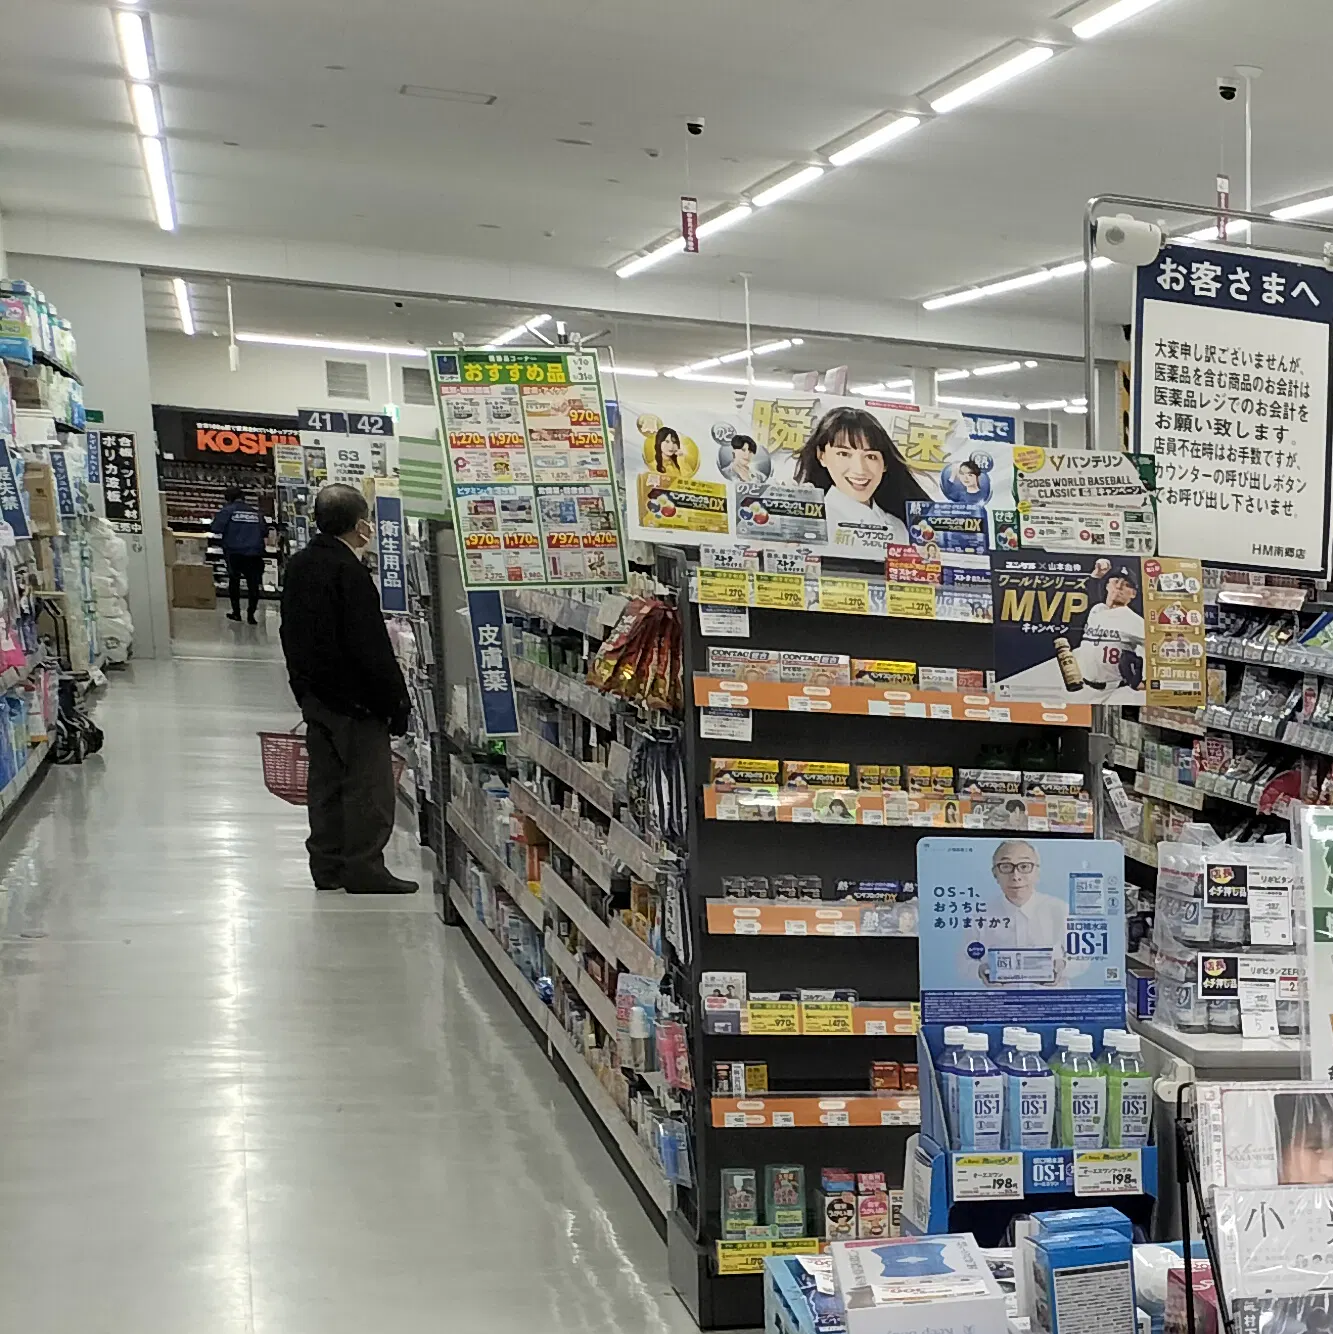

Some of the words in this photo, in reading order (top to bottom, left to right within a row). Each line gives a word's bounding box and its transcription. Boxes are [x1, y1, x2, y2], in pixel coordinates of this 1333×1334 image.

[1156, 257, 1320, 307] お客さまへ
[1154, 339, 1304, 376] 大変申し訳ございませんが、
[463, 362, 567, 383] おすすめ品
[1154, 362, 1311, 399] 医薬品を含む商品のお会計は
[1153, 386, 1309, 423] 医薬品レジでのお会計を
[308, 412, 331, 431] 41
[357, 415, 384, 434] 42
[1155, 412, 1298, 446] お願い致します。
[1067, 454, 1123, 469] バンテリン
[1153, 437, 1302, 471] 店員不在時はお手数ですが、
[1027, 478, 1051, 488] 2026
[1052, 476, 1086, 487] WORLD
[1087, 475, 1133, 486] BASEBALL
[1153, 463, 1308, 495] カウンターの呼び出しボタン
[1037, 487, 1077, 498] CLASSIC
[1153, 487, 1299, 519] でお呼び出し下さいませ。
[379, 520, 402, 588] 衛生用品
[998, 573, 1089, 588] ワールドシリーズ
[1000, 590, 1088, 623] MVP
[1021, 623, 1069, 634] キャンペーン
[478, 623, 508, 692] 皮膚薬
[712, 648, 750, 658] CONTAC
[1102, 646, 1120, 665] 18
[934, 901, 988, 914] おうちに
[933, 917, 1011, 929] ありますか?
[1066, 932, 1108, 955] OS-1
[974, 1099, 1000, 1115] OS-1
[1022, 1099, 1048, 1115] OS-1
